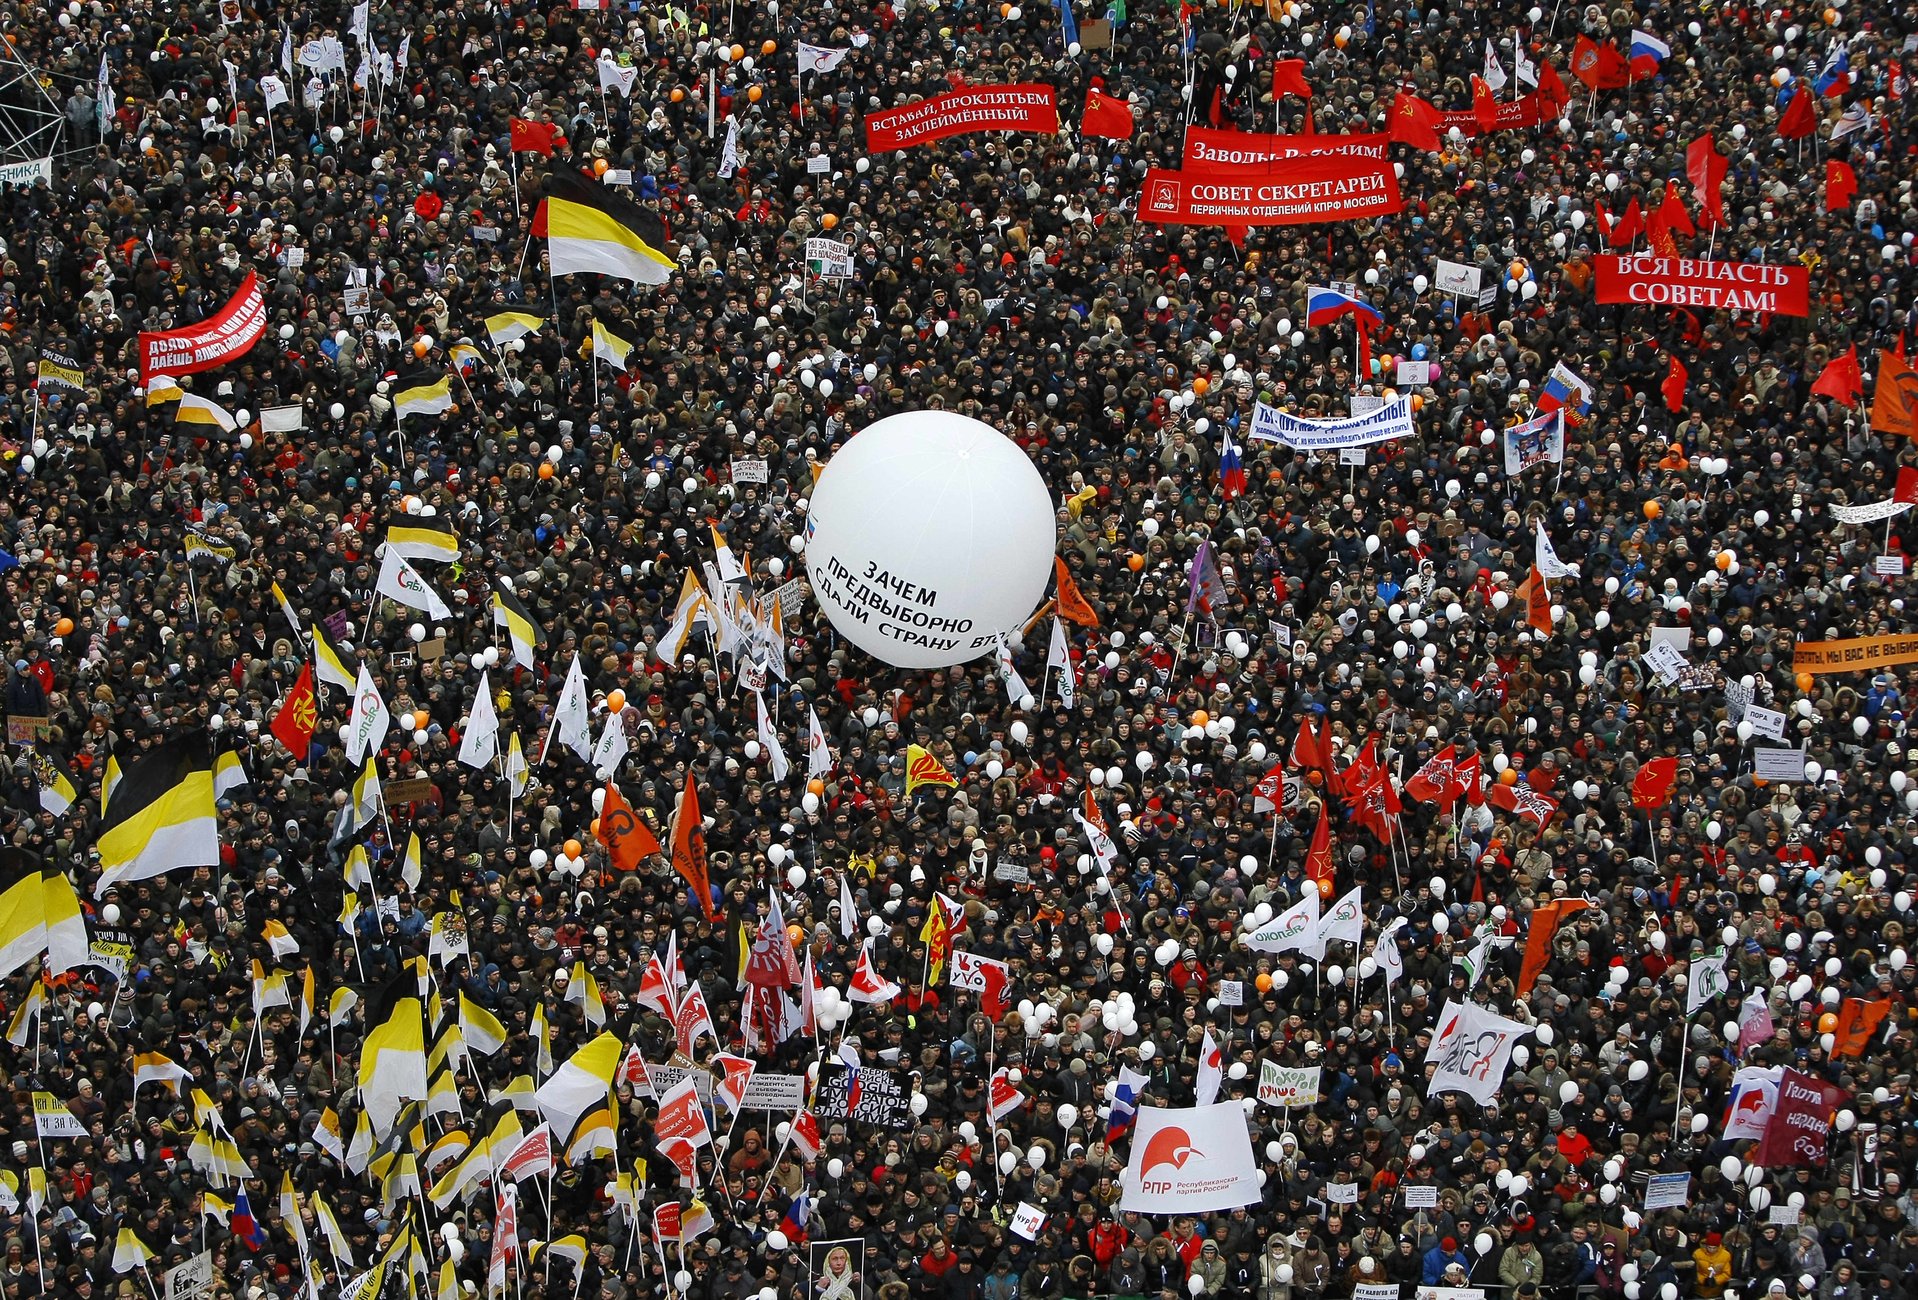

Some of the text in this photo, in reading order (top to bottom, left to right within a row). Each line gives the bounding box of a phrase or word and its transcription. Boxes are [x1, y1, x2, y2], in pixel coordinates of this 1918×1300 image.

[872, 93, 1050, 132] ВСТАВАЙ, ПРОКЛЯТЬЕМ
[895, 107, 1029, 142] ЗАКЛЕЙМЁННЫЙ!
[1190, 172, 1387, 201] СОВЕТ СЕКРЕТАРЕЙ
[1153, 202, 1175, 211] КПРФ
[1190, 194, 1388, 217] ПЕРВИЧНЫХ ОТДЕЛЕНИЙ КПРФ МОСКВЫ
[1617, 256, 1789, 286] ВСЯ ВЛАСТЬ
[1628, 282, 1777, 312] СОВЕТАМ!
[149, 352, 193, 371] ДАЁШЬ
[195, 343, 228, 362] ВЛАСТЬ
[827, 556, 974, 634] ПРЕДВЫБОРНО
[863, 560, 938, 608] ЗАЧЕМ
[815, 567, 870, 625] СДАЛИ
[878, 622, 961, 652] СТРАНУ
[1826, 650, 1842, 662] МЫ
[1845, 648, 1864, 661] ВАС
[1866, 645, 1880, 658] НЕ
[1750, 711, 1768, 721] ПОРА
[655, 1078, 698, 1088] ПУТА
[669, 1068, 683, 1076] НЕ
[821, 1087, 909, 1109] ИМПРАТОР
[829, 1097, 891, 1115] РОСИИ
[1142, 1181, 1172, 1195] РПР
[1176, 1175, 1239, 1190] Республиканская
[1176, 1185, 1230, 1196] партия России
